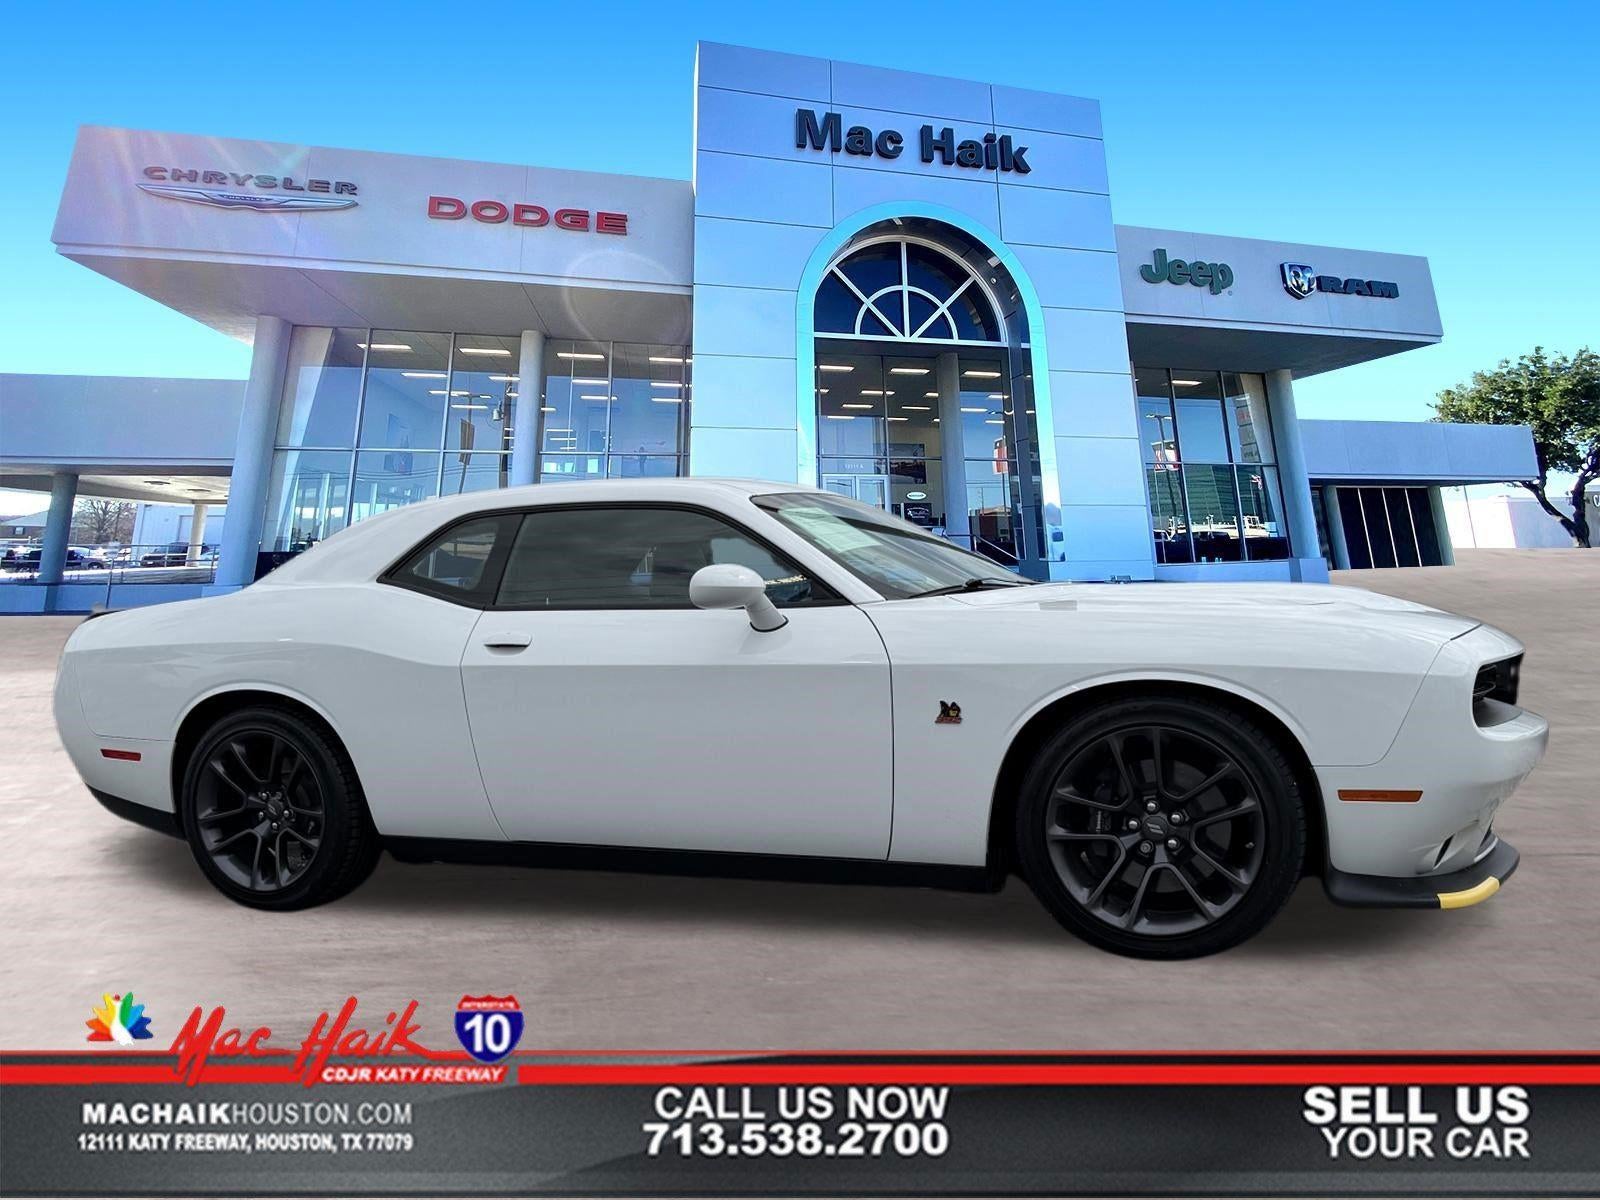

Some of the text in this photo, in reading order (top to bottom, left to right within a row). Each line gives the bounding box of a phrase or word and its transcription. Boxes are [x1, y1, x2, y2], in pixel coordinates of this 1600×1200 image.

[795, 108, 1032, 174] Mac Haik
[143, 166, 359, 196] CHRYSLER
[428, 195, 628, 236] DODGE
[1139, 248, 1235, 296] Jeep
[1315, 275, 1400, 299] RAM
